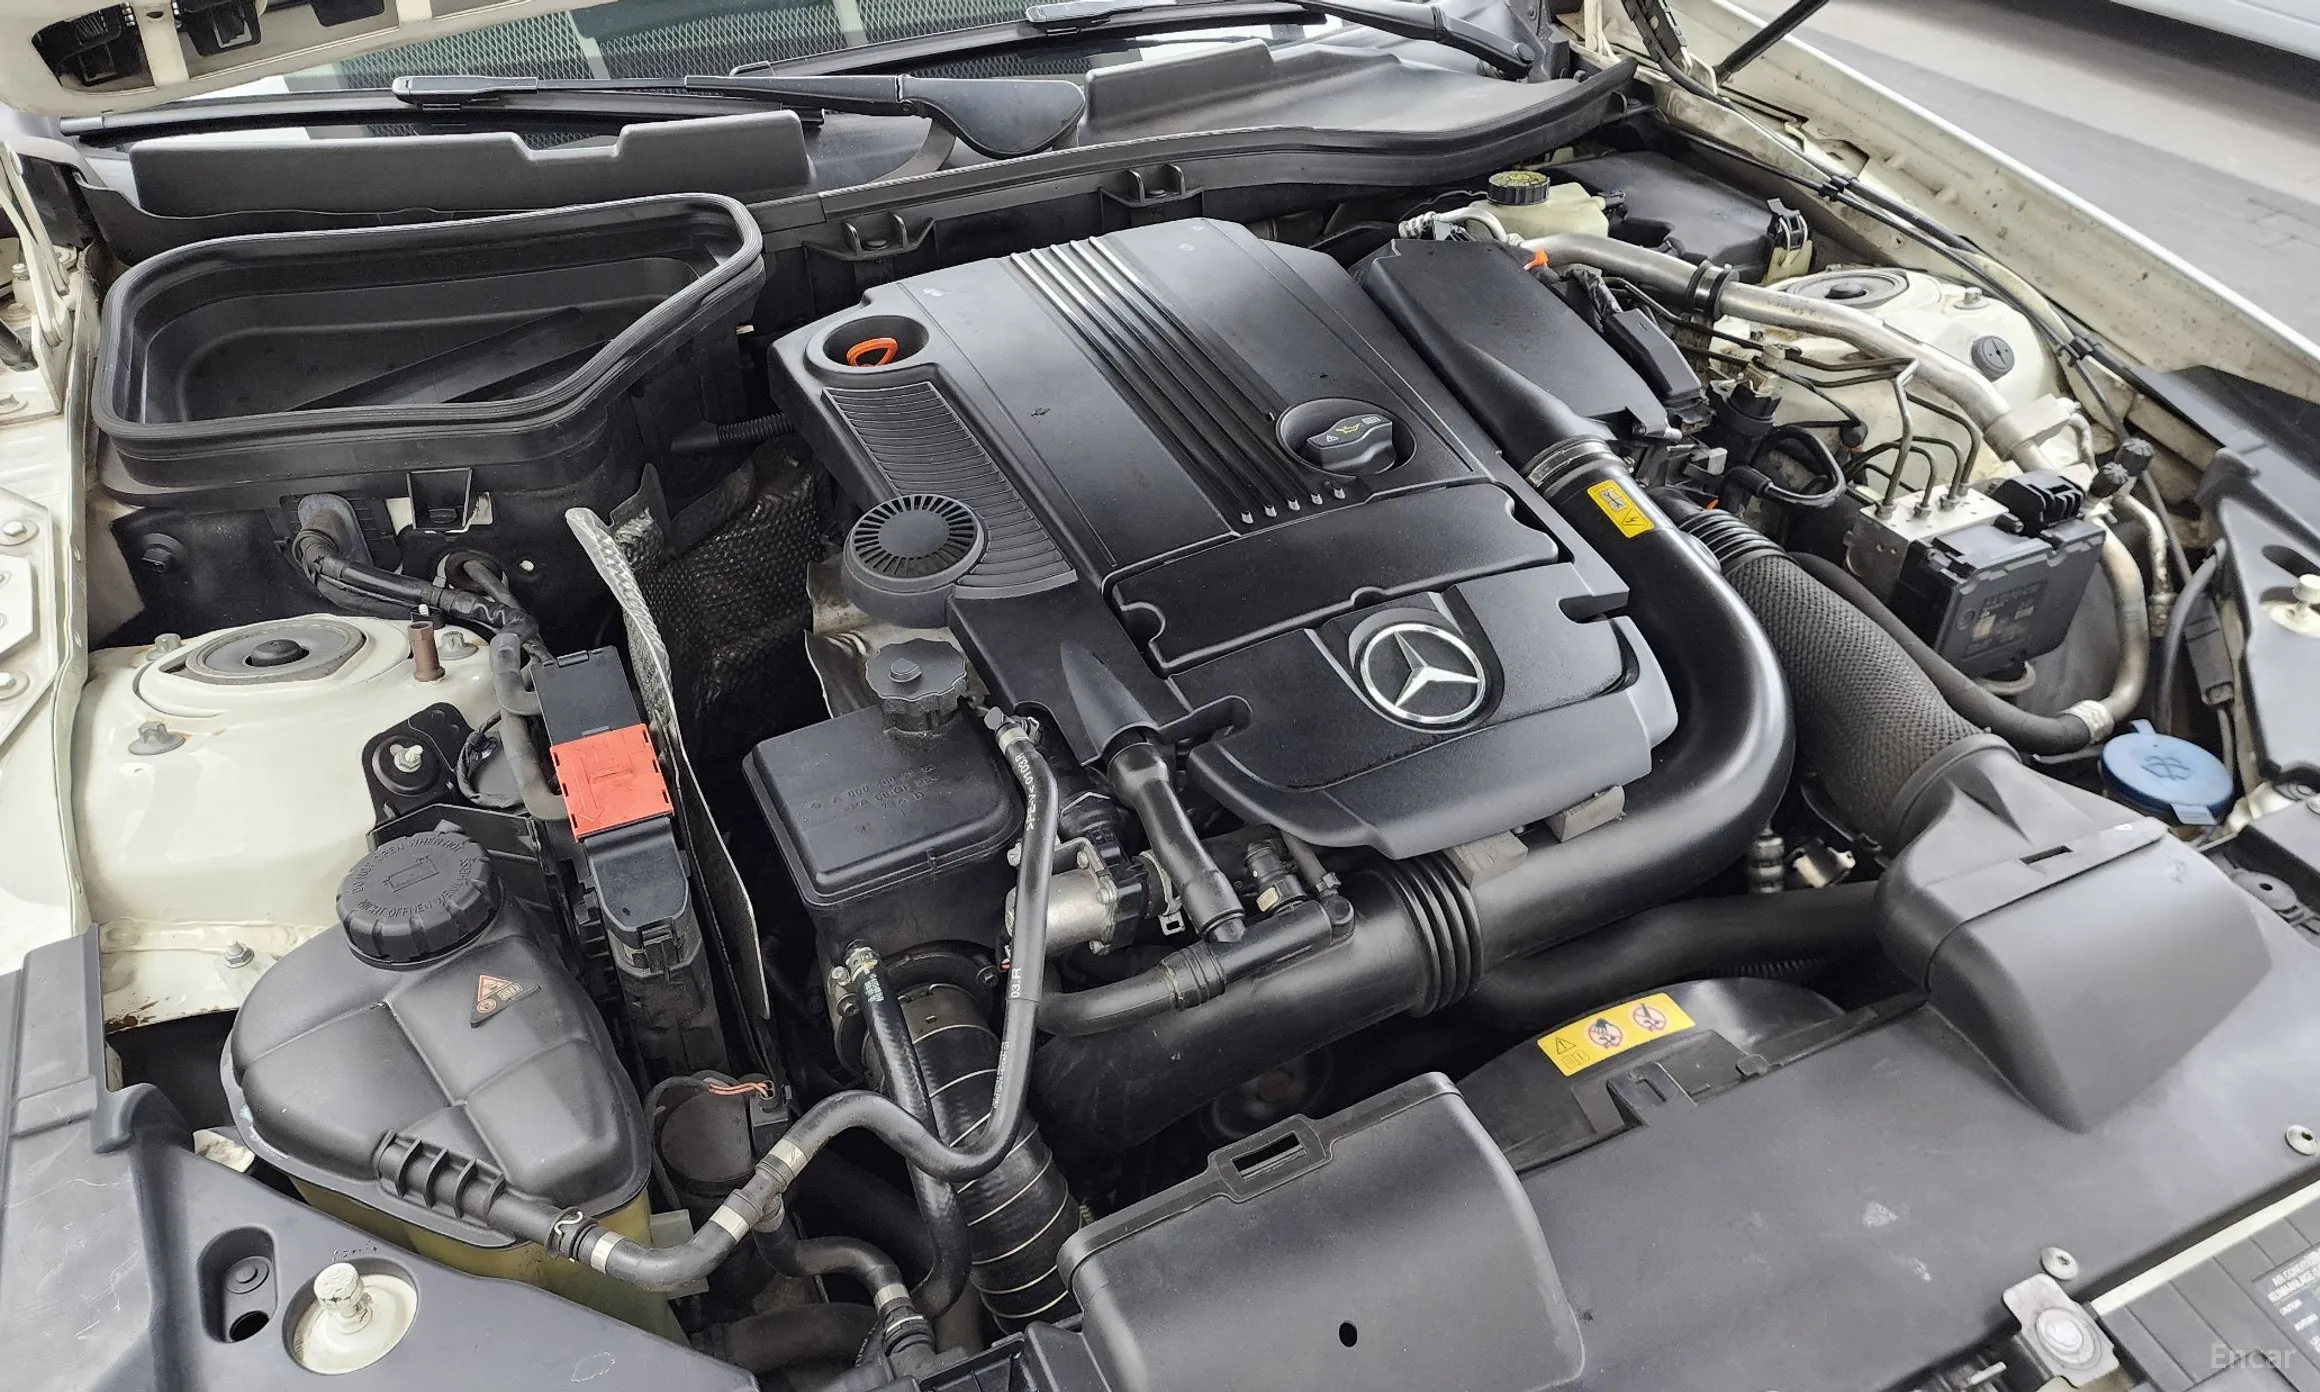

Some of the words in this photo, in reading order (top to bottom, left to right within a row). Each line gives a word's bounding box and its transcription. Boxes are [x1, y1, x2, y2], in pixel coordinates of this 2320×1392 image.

[374, 843, 405, 863] OPEN
[407, 837, 442, 849] WHEN
[440, 840, 465, 853] HOT
[356, 898, 388, 917] NICHT
